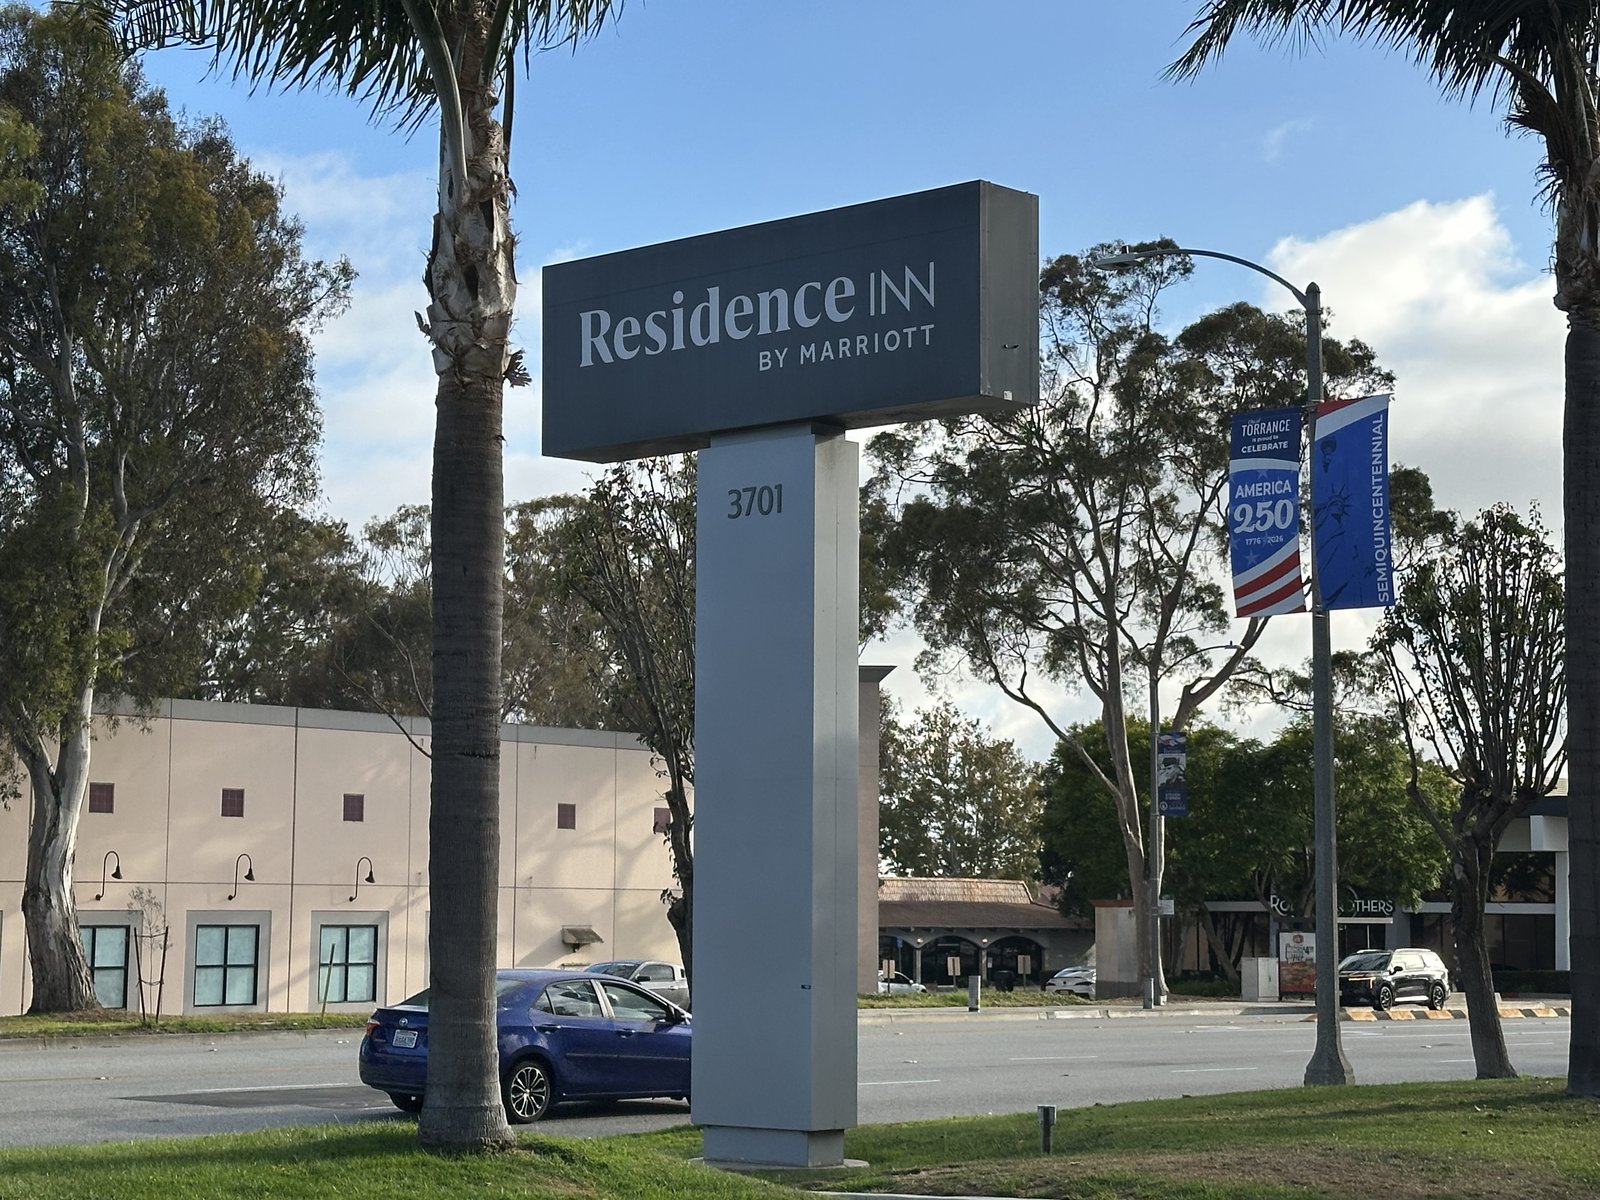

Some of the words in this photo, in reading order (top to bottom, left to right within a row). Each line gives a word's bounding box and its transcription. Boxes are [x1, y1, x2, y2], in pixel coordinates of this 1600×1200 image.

[579, 276, 856, 368] Residence
[870, 261, 935, 316] INN
[759, 347, 788, 371] BY
[800, 324, 935, 365] MARRIOTT
[1241, 419, 1291, 437] TORRANCE
[1241, 441, 1289, 453] CELEBRATE
[727, 484, 783, 519] 3701
[1235, 480, 1292, 499] AMERICA
[1233, 499, 1294, 534] 250
[1372, 414, 1390, 602] SEMIQUINCENTENNIAL
[1245, 537, 1261, 546] 1776
[1267, 535, 1284, 544] 2026
